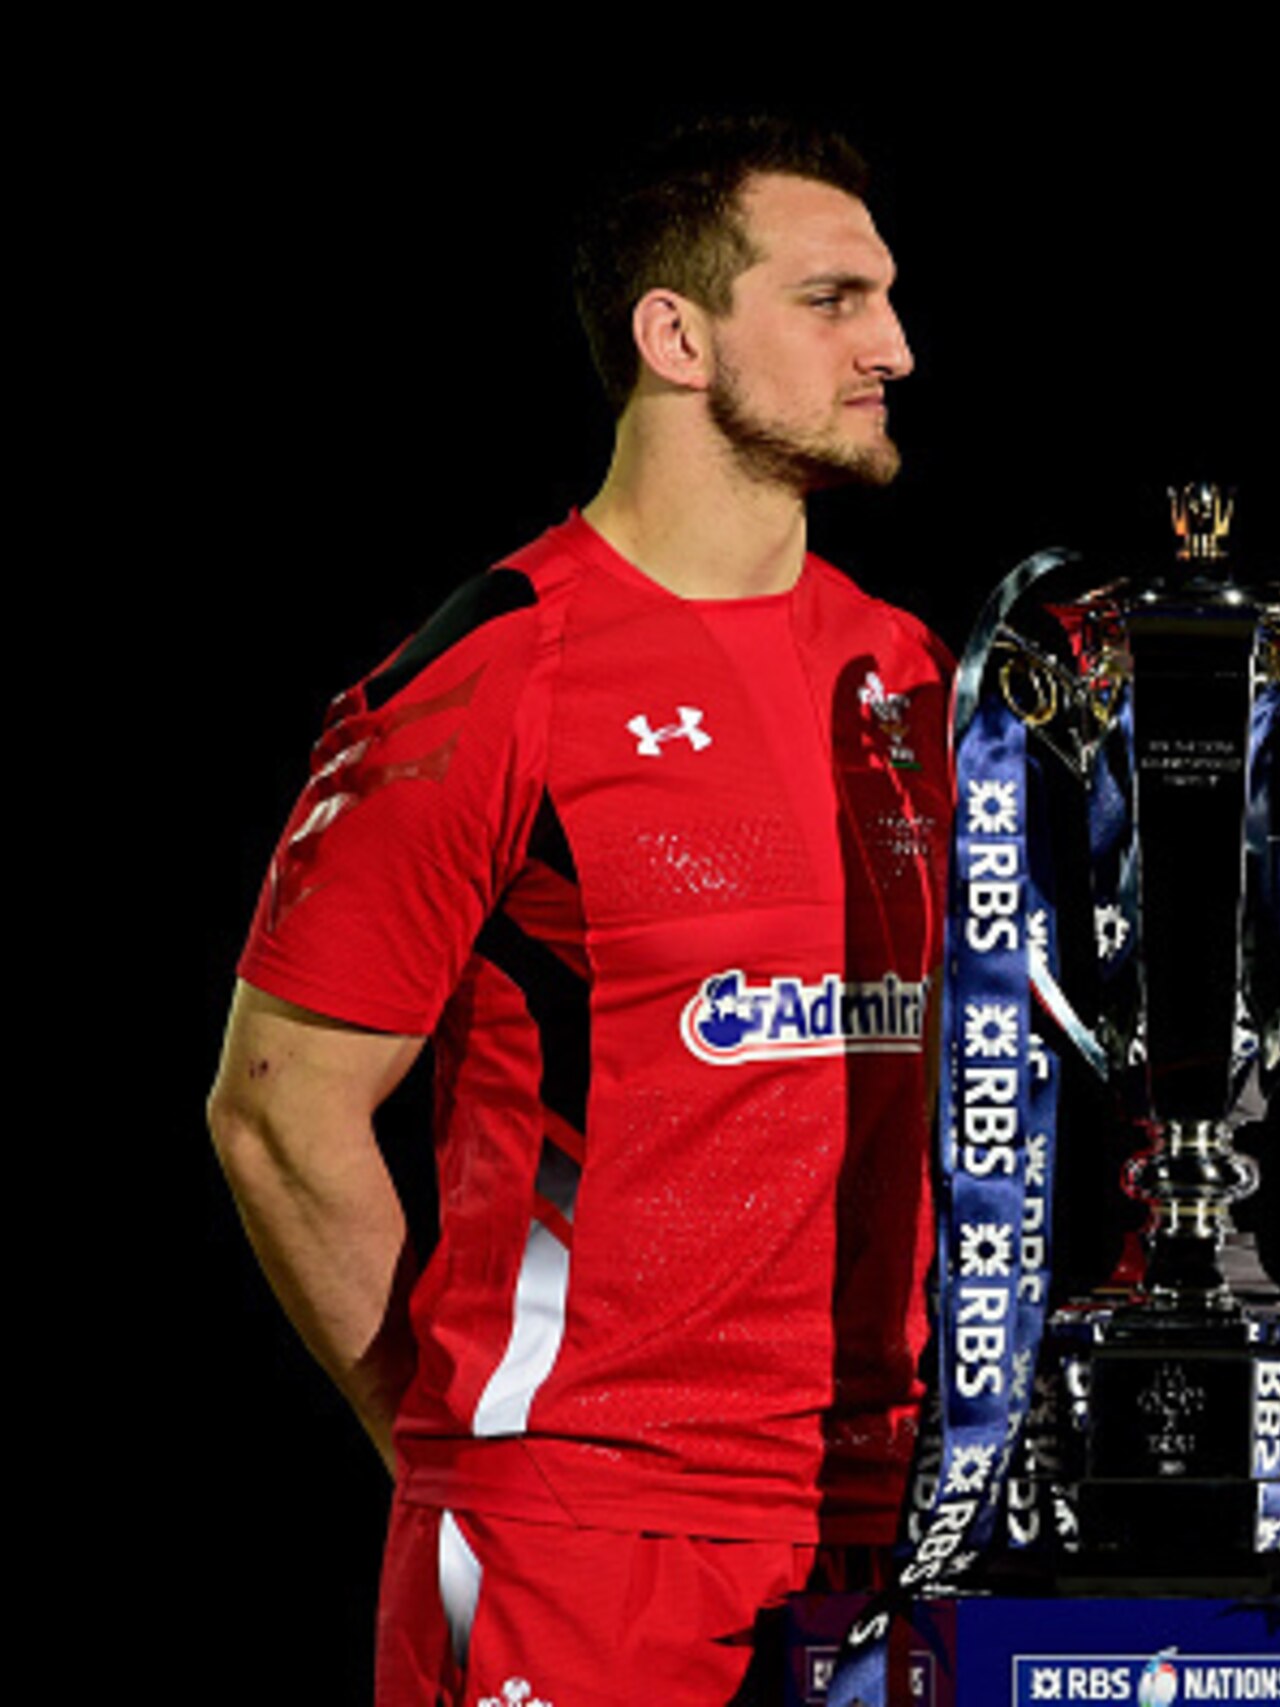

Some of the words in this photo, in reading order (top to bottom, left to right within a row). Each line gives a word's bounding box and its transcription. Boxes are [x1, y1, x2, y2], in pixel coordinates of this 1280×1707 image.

[966, 843, 1019, 951] RBS
[964, 1068, 1018, 1176] RBS
[956, 1287, 1010, 1398] RBS
[900, 1499, 979, 1587] RBS
[1067, 1667, 1131, 1700] RBS
